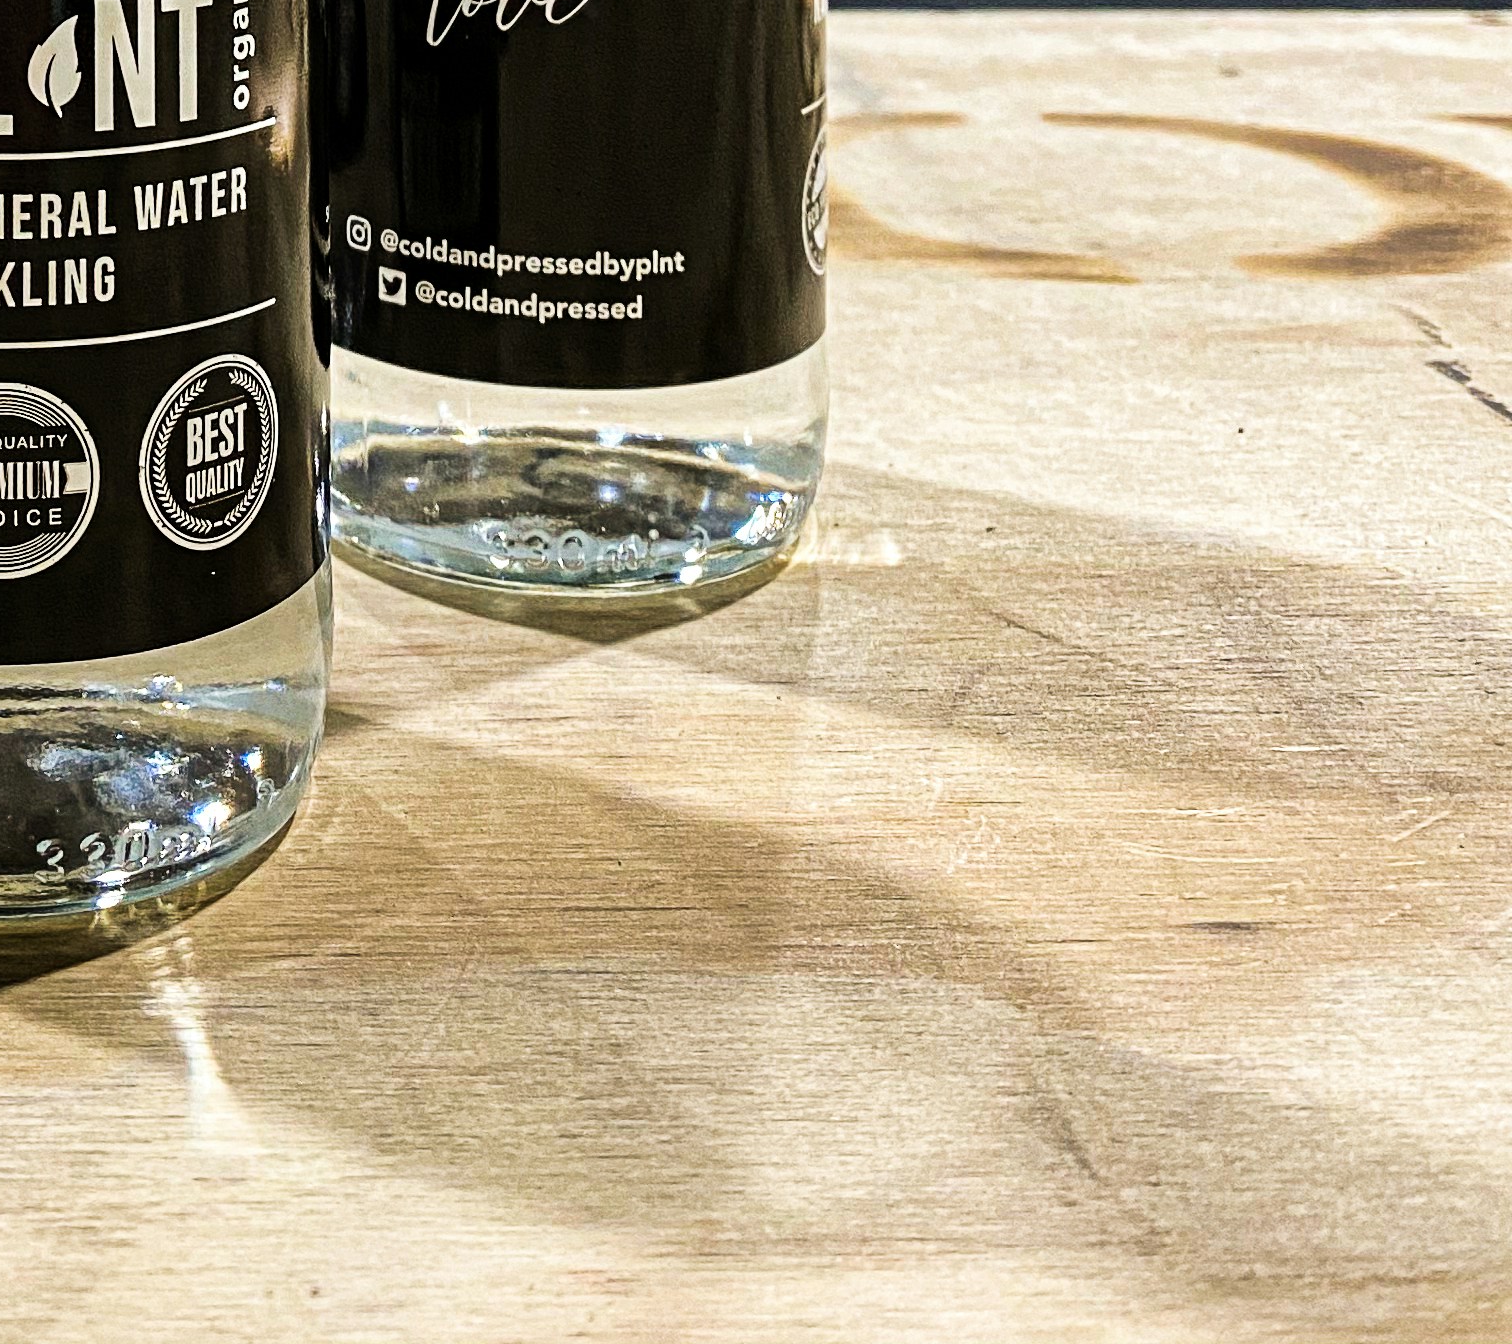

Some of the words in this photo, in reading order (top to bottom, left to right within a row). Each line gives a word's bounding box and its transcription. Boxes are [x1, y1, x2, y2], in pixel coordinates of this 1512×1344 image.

[133, 166, 248, 232] WATER
[380, 228, 686, 281] @coldandpressedbyplnt
[415, 281, 644, 324] @coldandpressed
[187, 402, 248, 468] BEST
[185, 456, 245, 504] QUALITY
